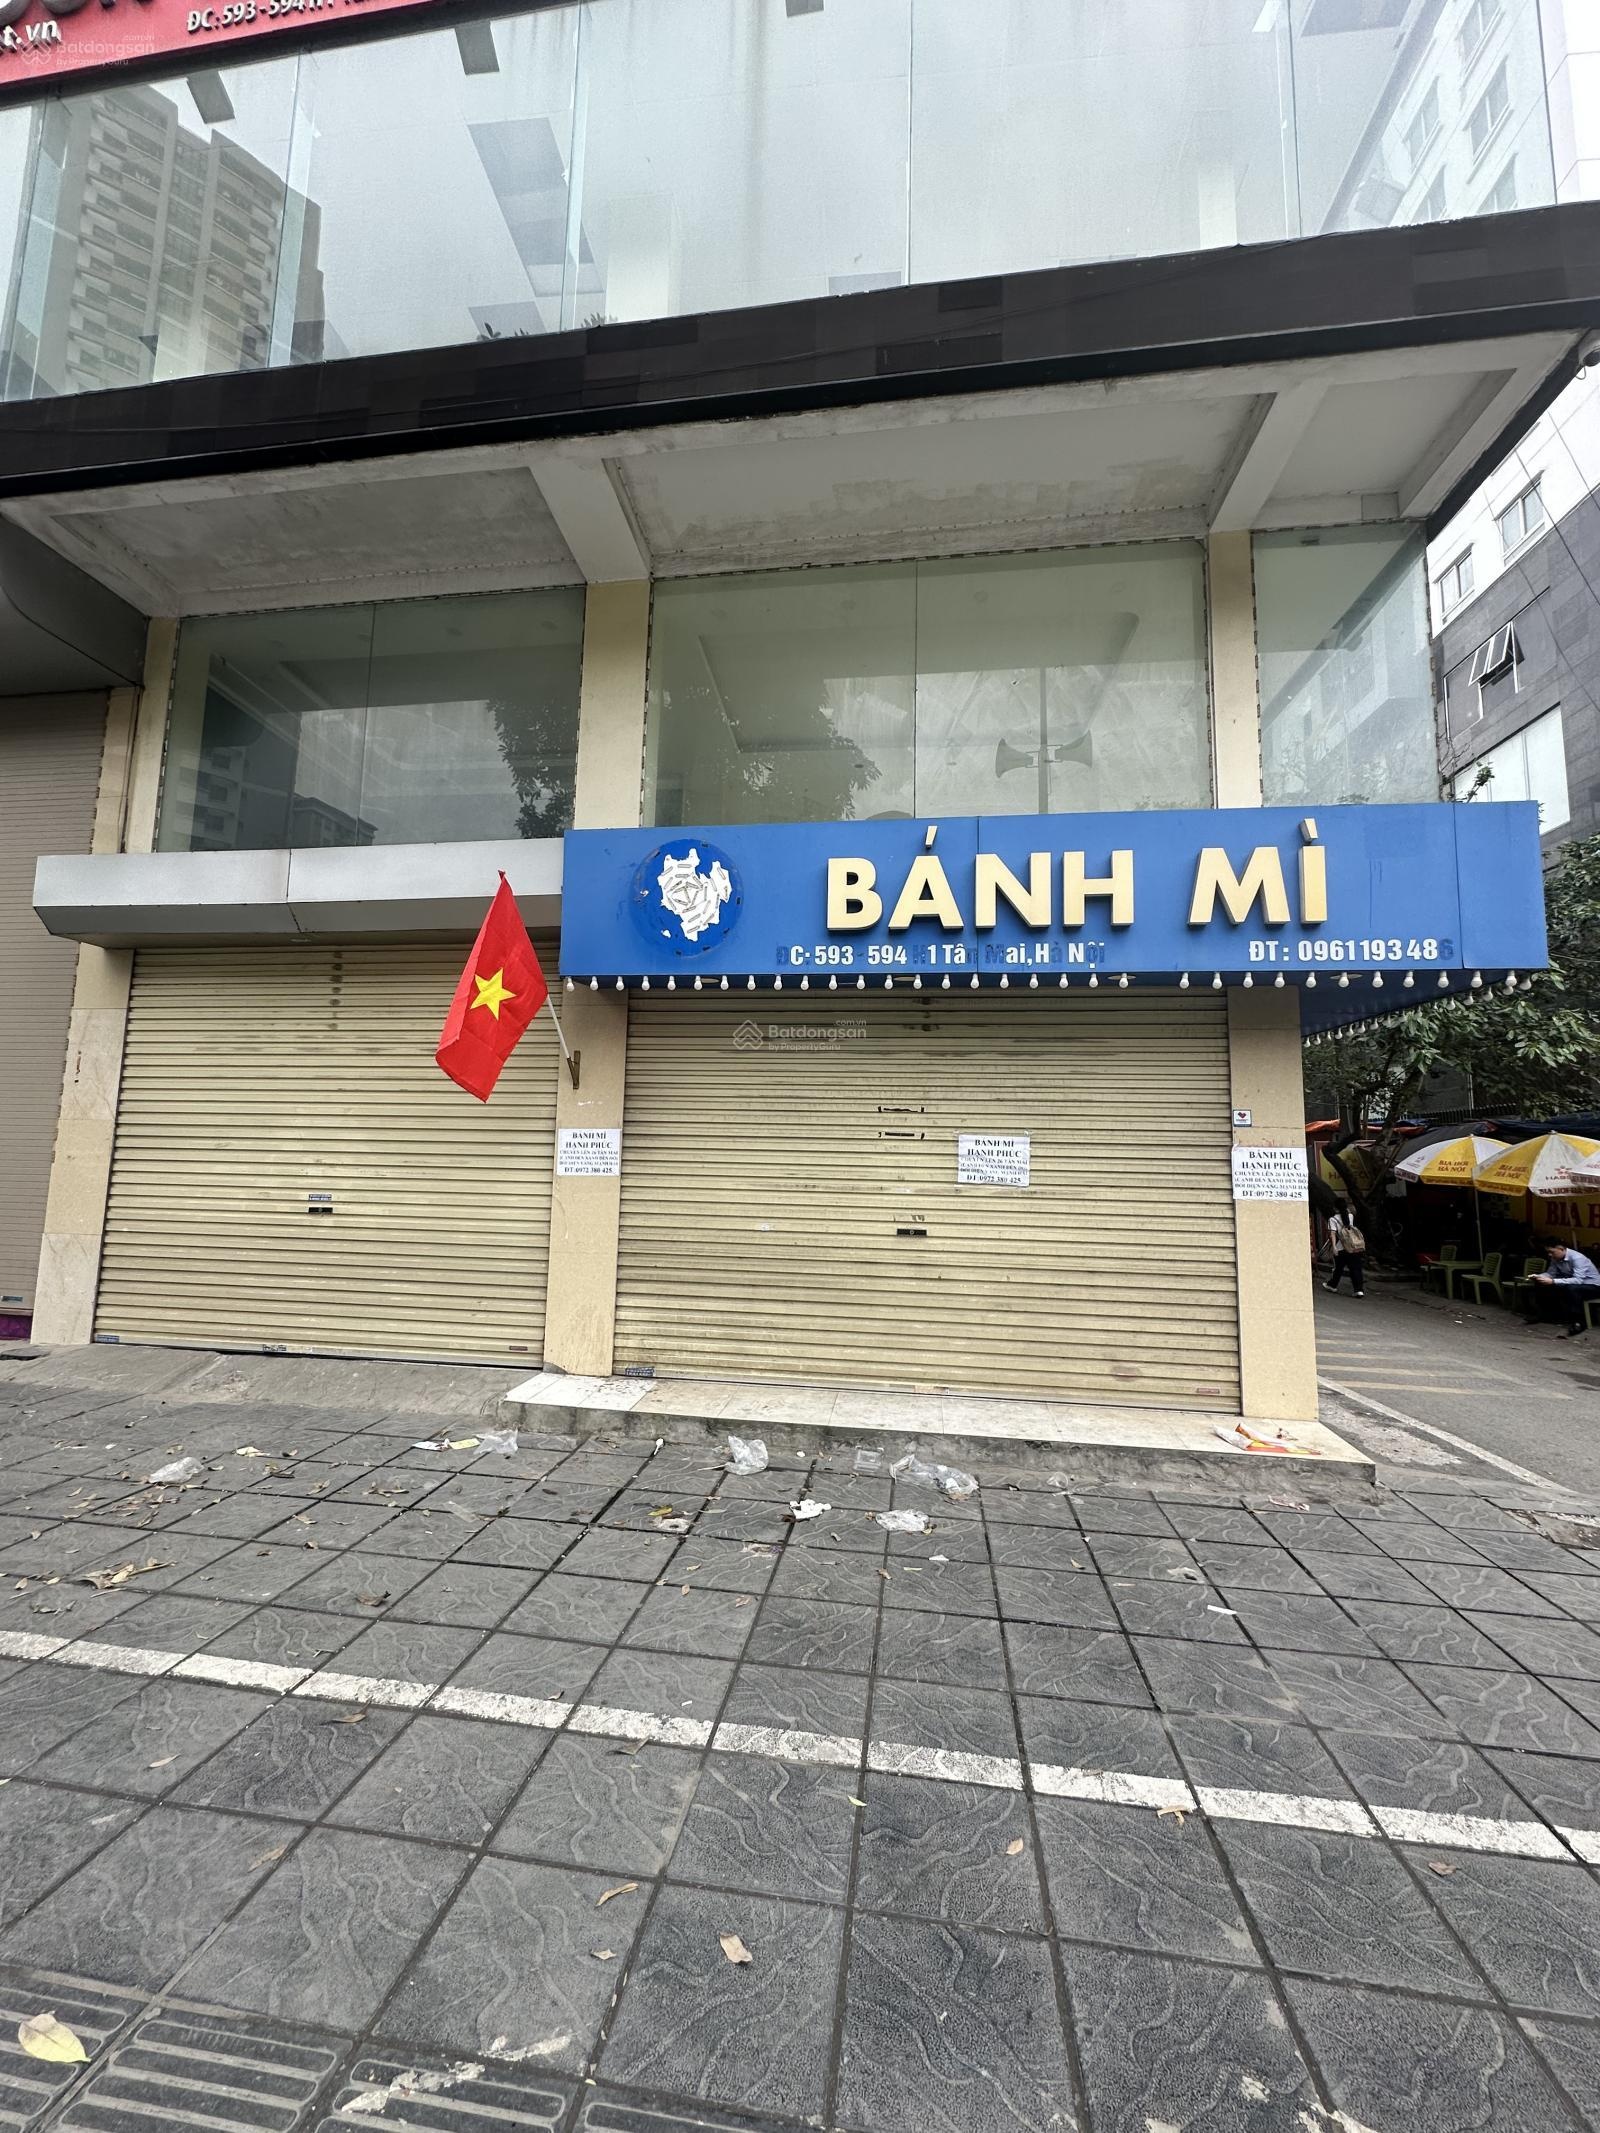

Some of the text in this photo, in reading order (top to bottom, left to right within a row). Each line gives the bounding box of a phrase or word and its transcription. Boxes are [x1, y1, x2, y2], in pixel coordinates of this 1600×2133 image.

[826, 817, 1328, 931] BÁNH MÌ
[814, 944, 854, 965] 593
[867, 944, 908, 965] 594
